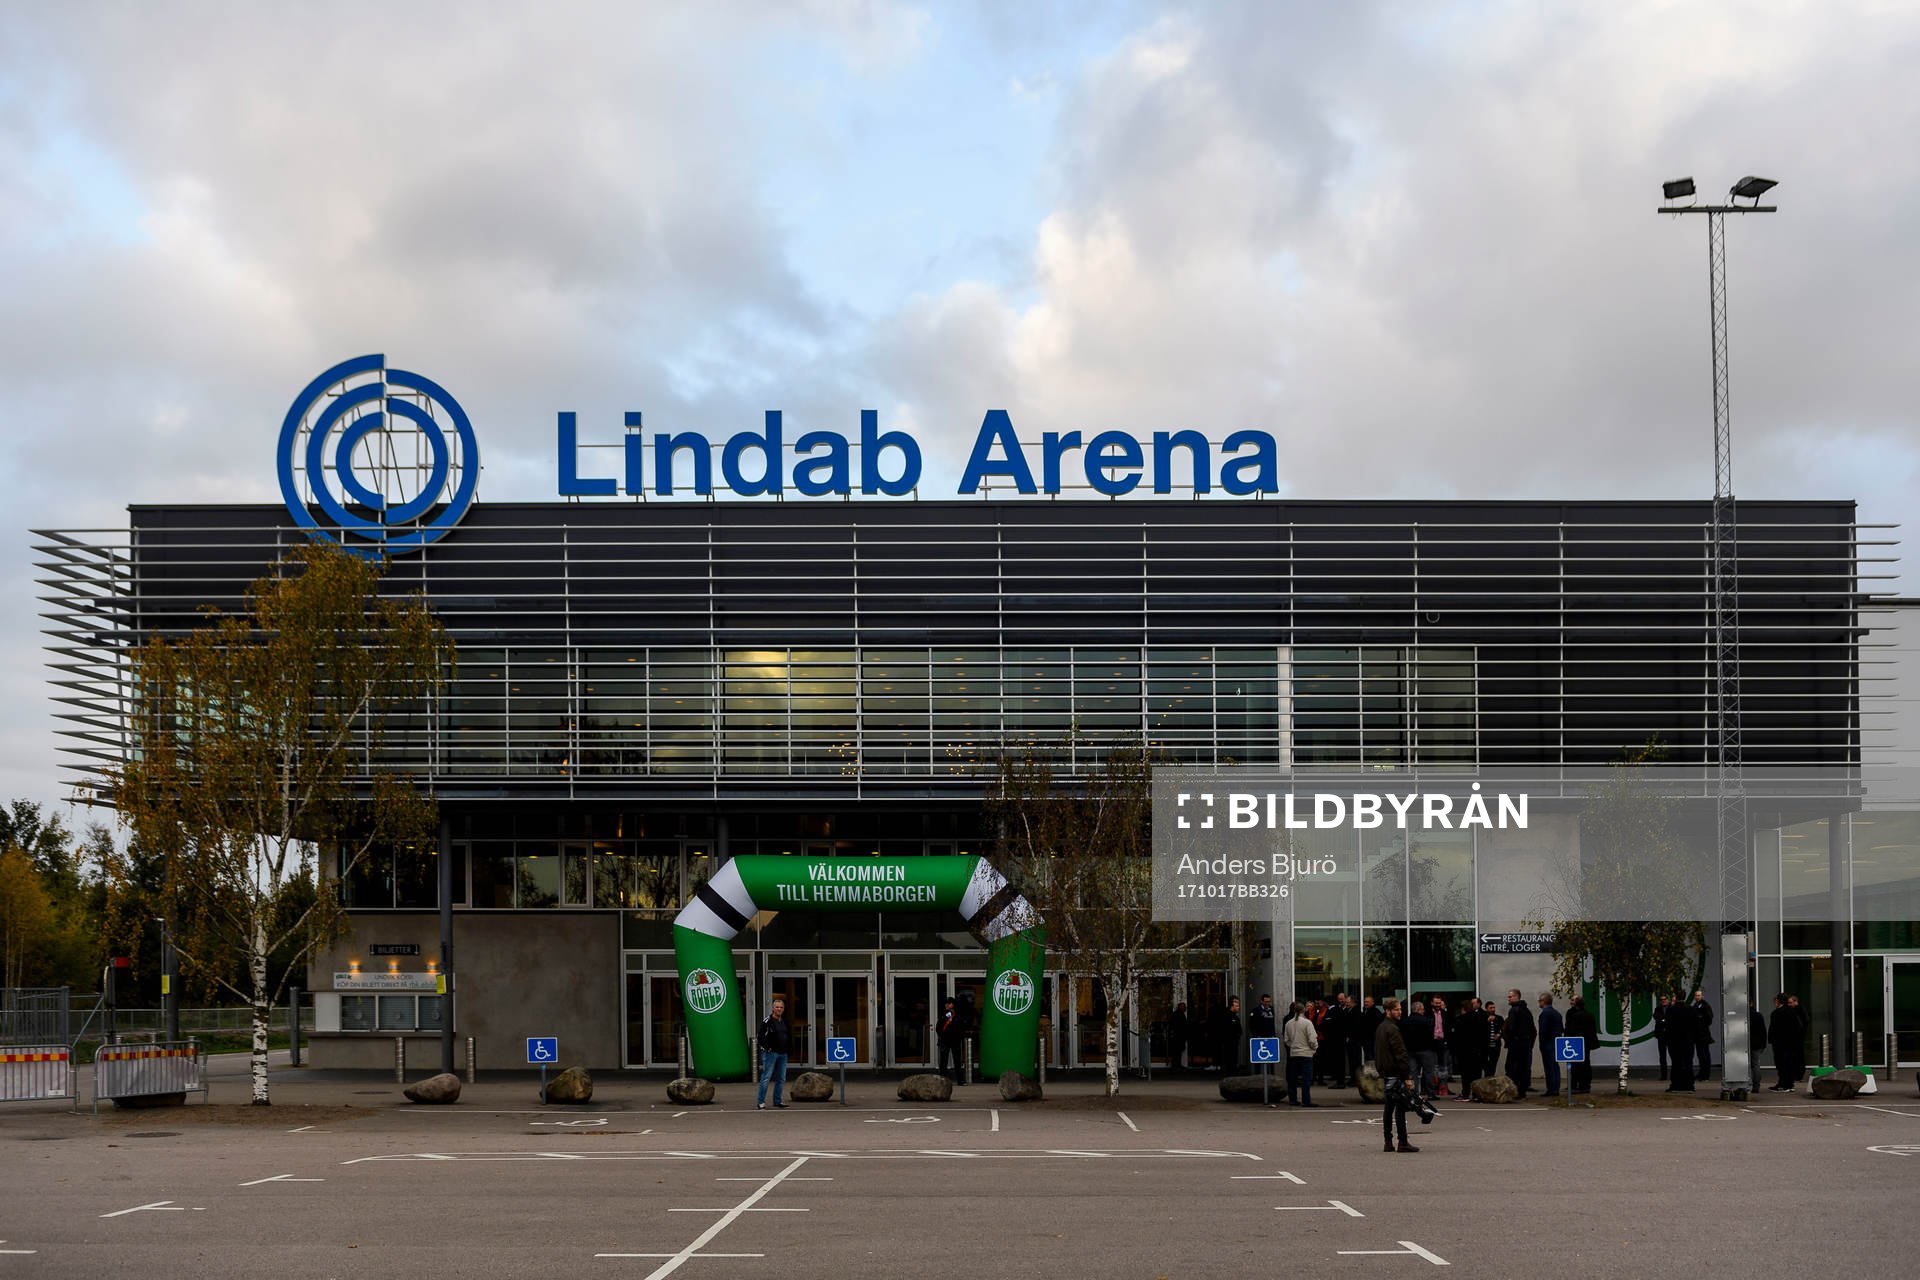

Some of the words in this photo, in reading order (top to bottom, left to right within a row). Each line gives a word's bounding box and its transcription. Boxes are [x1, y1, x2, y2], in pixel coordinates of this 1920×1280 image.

[558, 410, 922, 496] Lindab
[958, 410, 1277, 495] Arena
[808, 863, 905, 882] VÄLKOMMEN
[776, 884, 809, 902] TILL
[812, 885, 936, 902] HEMMABORGEN
[1512, 944, 1540, 952] LOGER
[691, 986, 722, 1009] RÖGLE
[998, 986, 1029, 1010] RÖGLE
